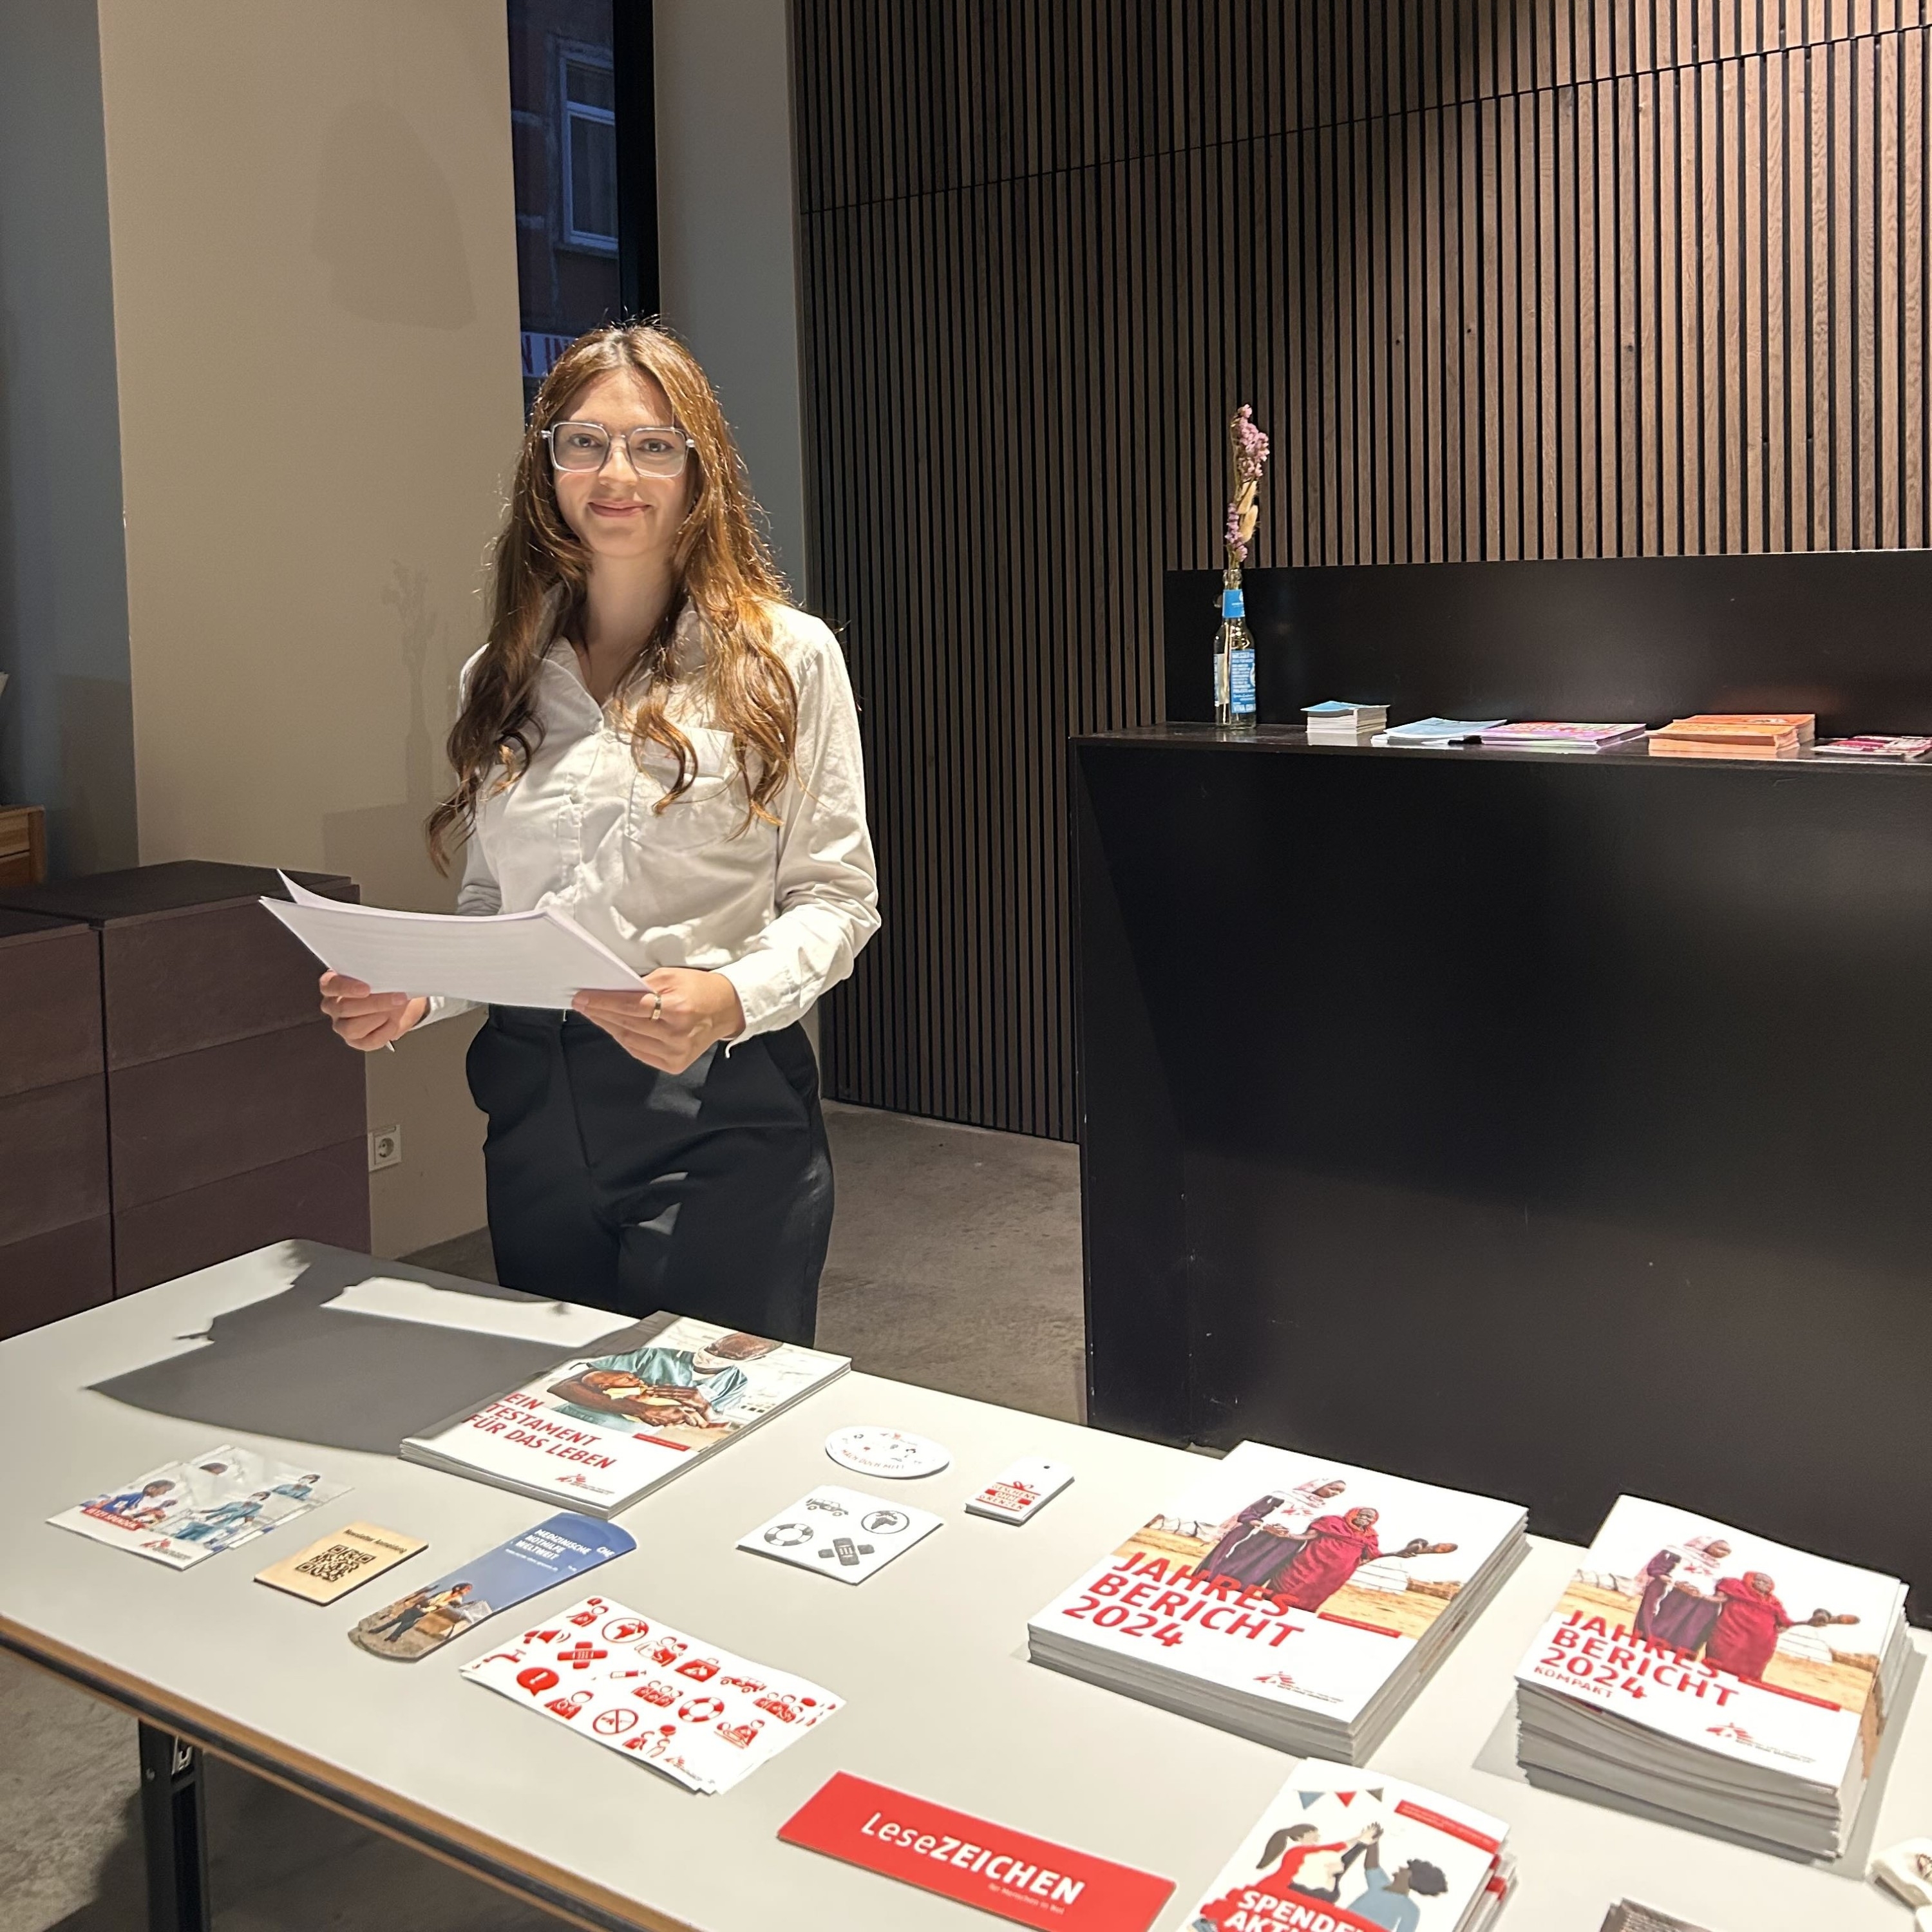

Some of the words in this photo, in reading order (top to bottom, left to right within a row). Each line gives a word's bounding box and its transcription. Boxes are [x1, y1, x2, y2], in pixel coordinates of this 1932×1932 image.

[486, 1403, 602, 1446] TESTAMENT
[504, 1393, 545, 1410] EIN
[461, 1414, 507, 1434] FÜR
[504, 1430, 550, 1448] DAS
[545, 1444, 618, 1469] LEBEN
[515, 1540, 560, 1560] WELTWEIT
[524, 1534, 567, 1554] NOTHILFE
[534, 1529, 592, 1555] MEDIZINISCHE
[1088, 1572, 1305, 1647] BERICHT
[1112, 1551, 1300, 1617] JAHRES
[1061, 1595, 1184, 1647] 2024
[1562, 1609, 1723, 1679] JAHRES
[1534, 1665, 1613, 1698] KOMPAKT
[1540, 1647, 1647, 1700] 2024
[1552, 1627, 1740, 1707] BERICHT
[861, 1812, 1086, 1905] LeseZEICHEN
[1237, 1890, 1366, 1932] SPENDE
